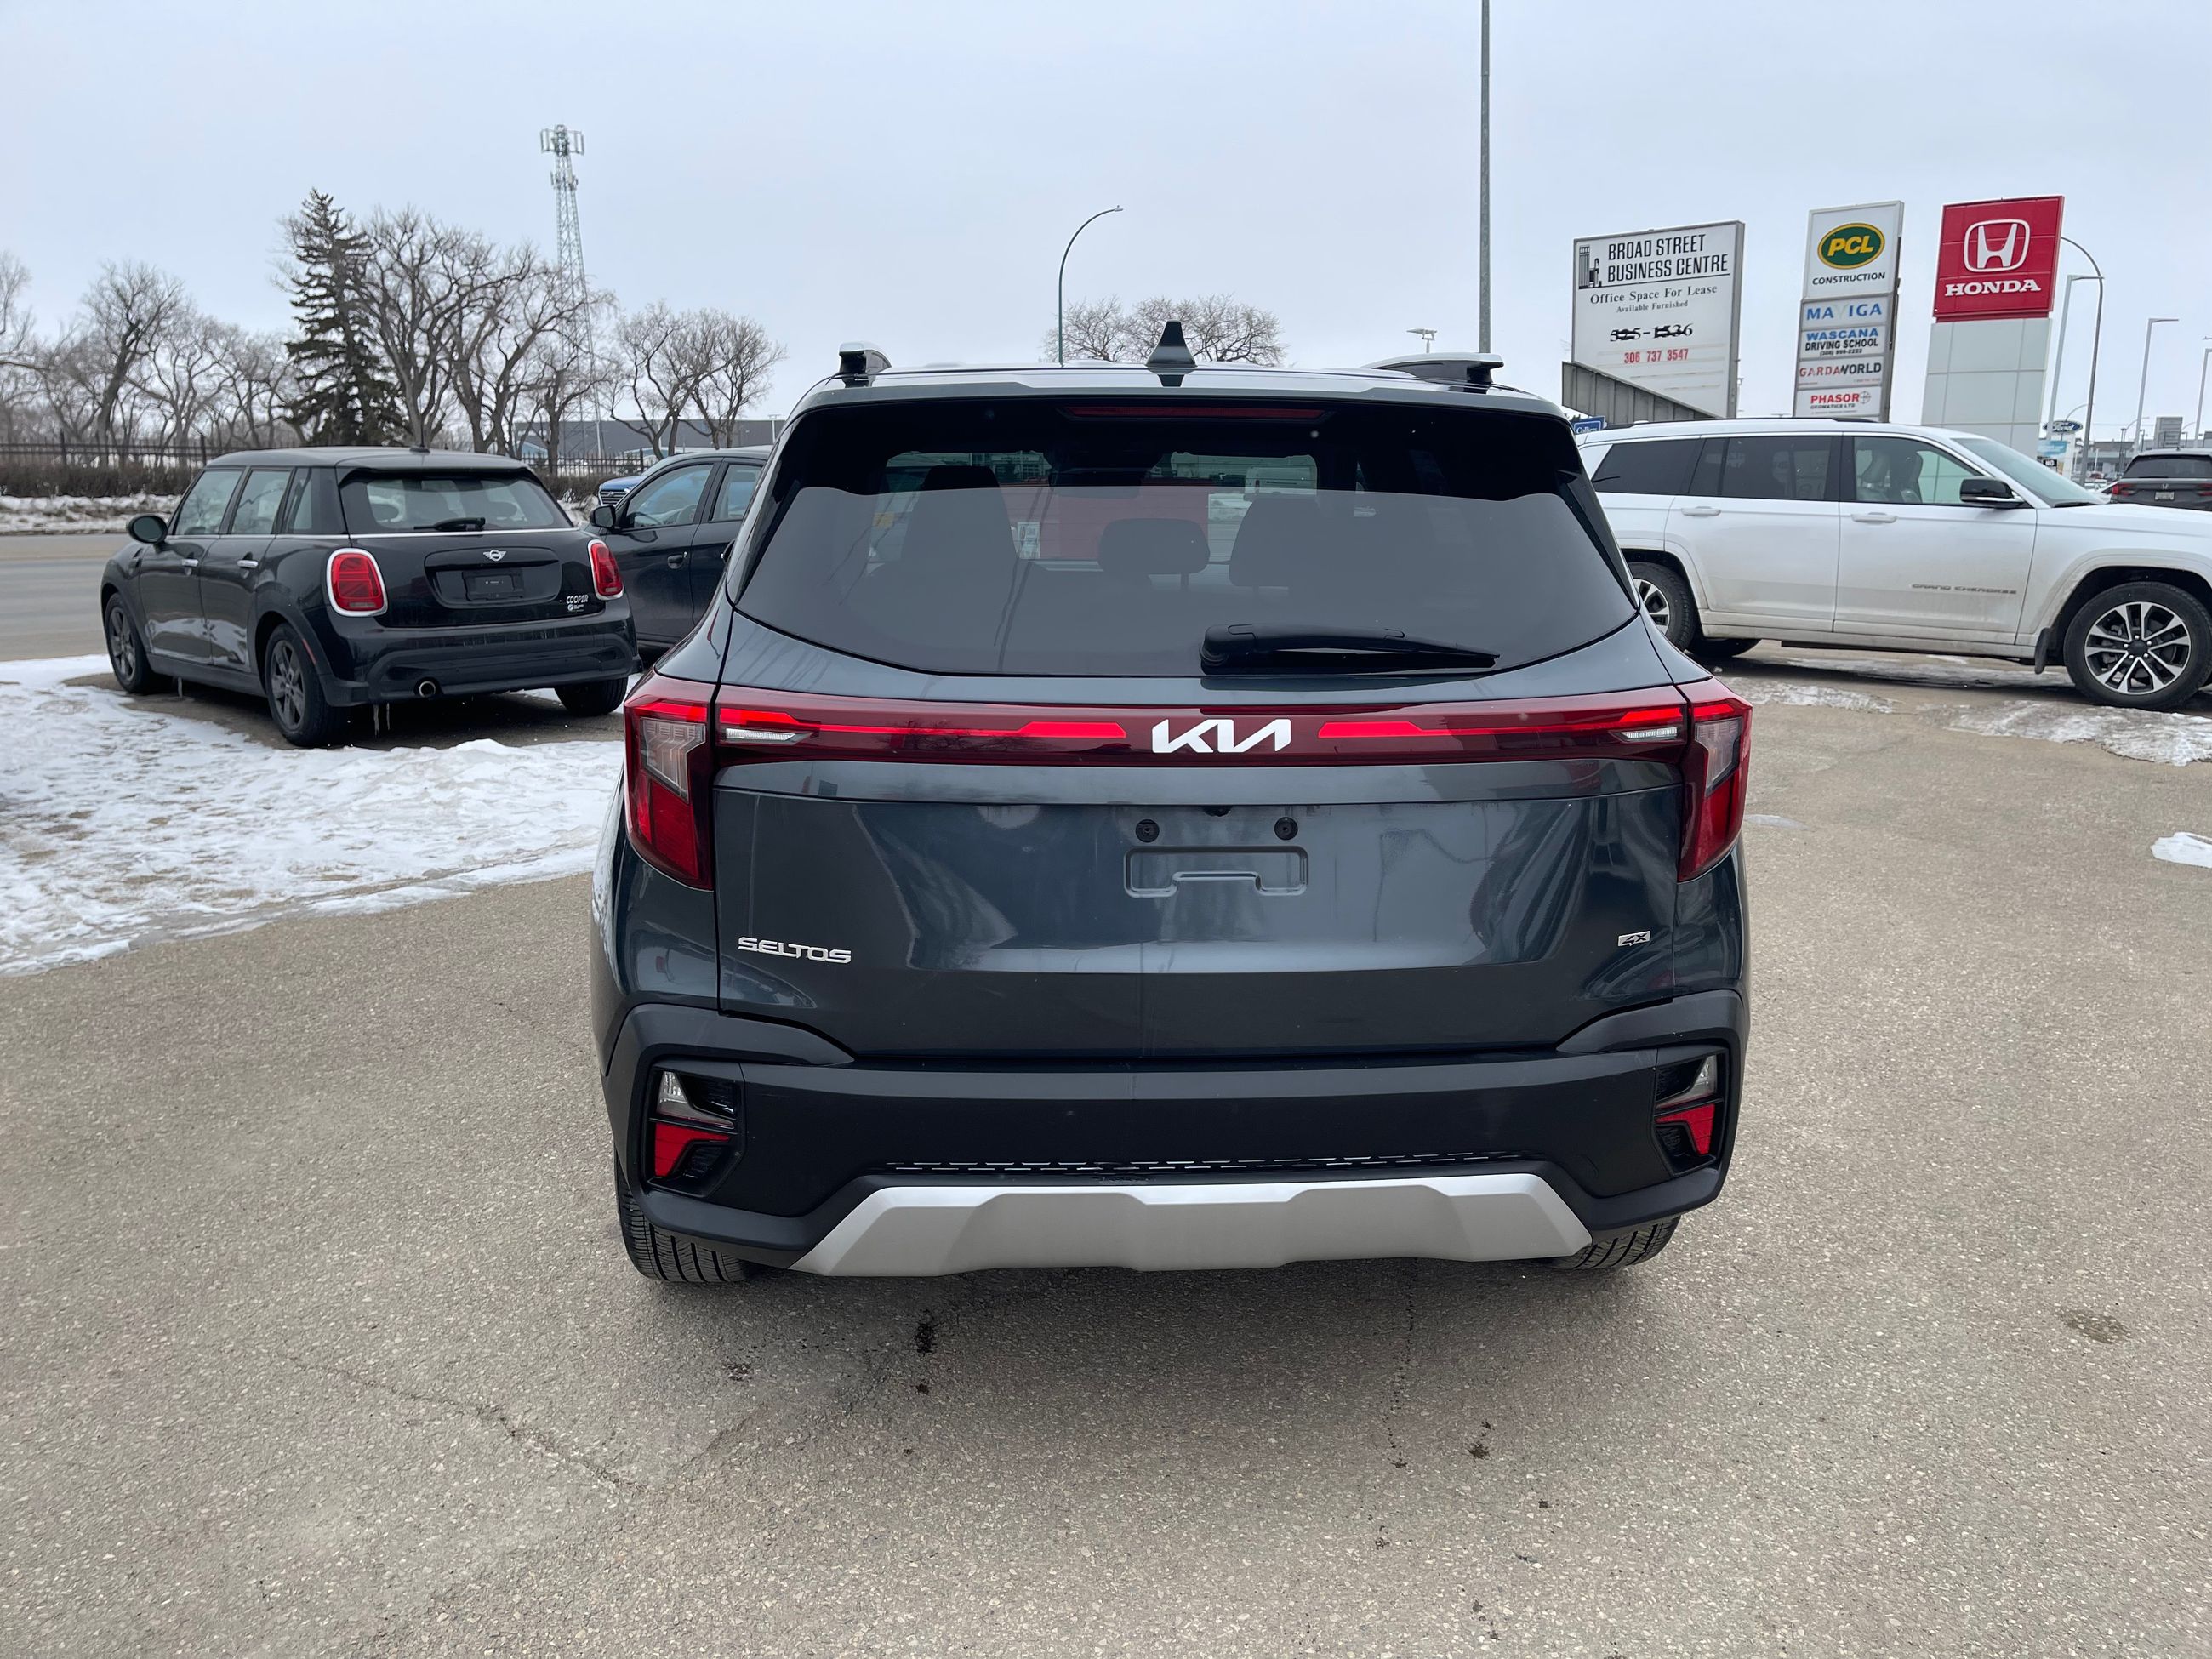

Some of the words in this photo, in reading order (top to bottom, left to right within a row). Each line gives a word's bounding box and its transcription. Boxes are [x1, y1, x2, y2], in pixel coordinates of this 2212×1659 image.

[1609, 240, 1652, 260] BROAD
[1656, 234, 1706, 255] STREET
[1827, 235, 1873, 256] PCL
[1608, 259, 1672, 282] BUSINESS
[1676, 254, 1729, 276] CENTRE
[1812, 272, 1885, 285] CONSTRUCTION
[1590, 293, 1625, 305] Office
[1629, 291, 1660, 303] Space
[1664, 288, 1682, 299] For
[1688, 285, 1718, 296] Lease
[1945, 279, 2042, 297] HONDA
[1616, 304, 1649, 313] Available
[1651, 300, 1689, 310] Furnished
[1806, 328, 1879, 341] WASCANA
[1805, 340, 1841, 351] DRIVING
[1843, 338, 1878, 349] SCHOOL
[1624, 352, 1640, 364] 306
[1646, 350, 1662, 362] 737
[1667, 348, 1689, 362] 3547
[1799, 362, 1882, 378] GARDAWORLD
[1810, 393, 1860, 404] PHASOR
[1954, 585, 2016, 595] CHEROKEE
[566, 594, 589, 604] COOPER
[1152, 719, 1291, 754] KIA
[738, 937, 852, 964] SELTOS
